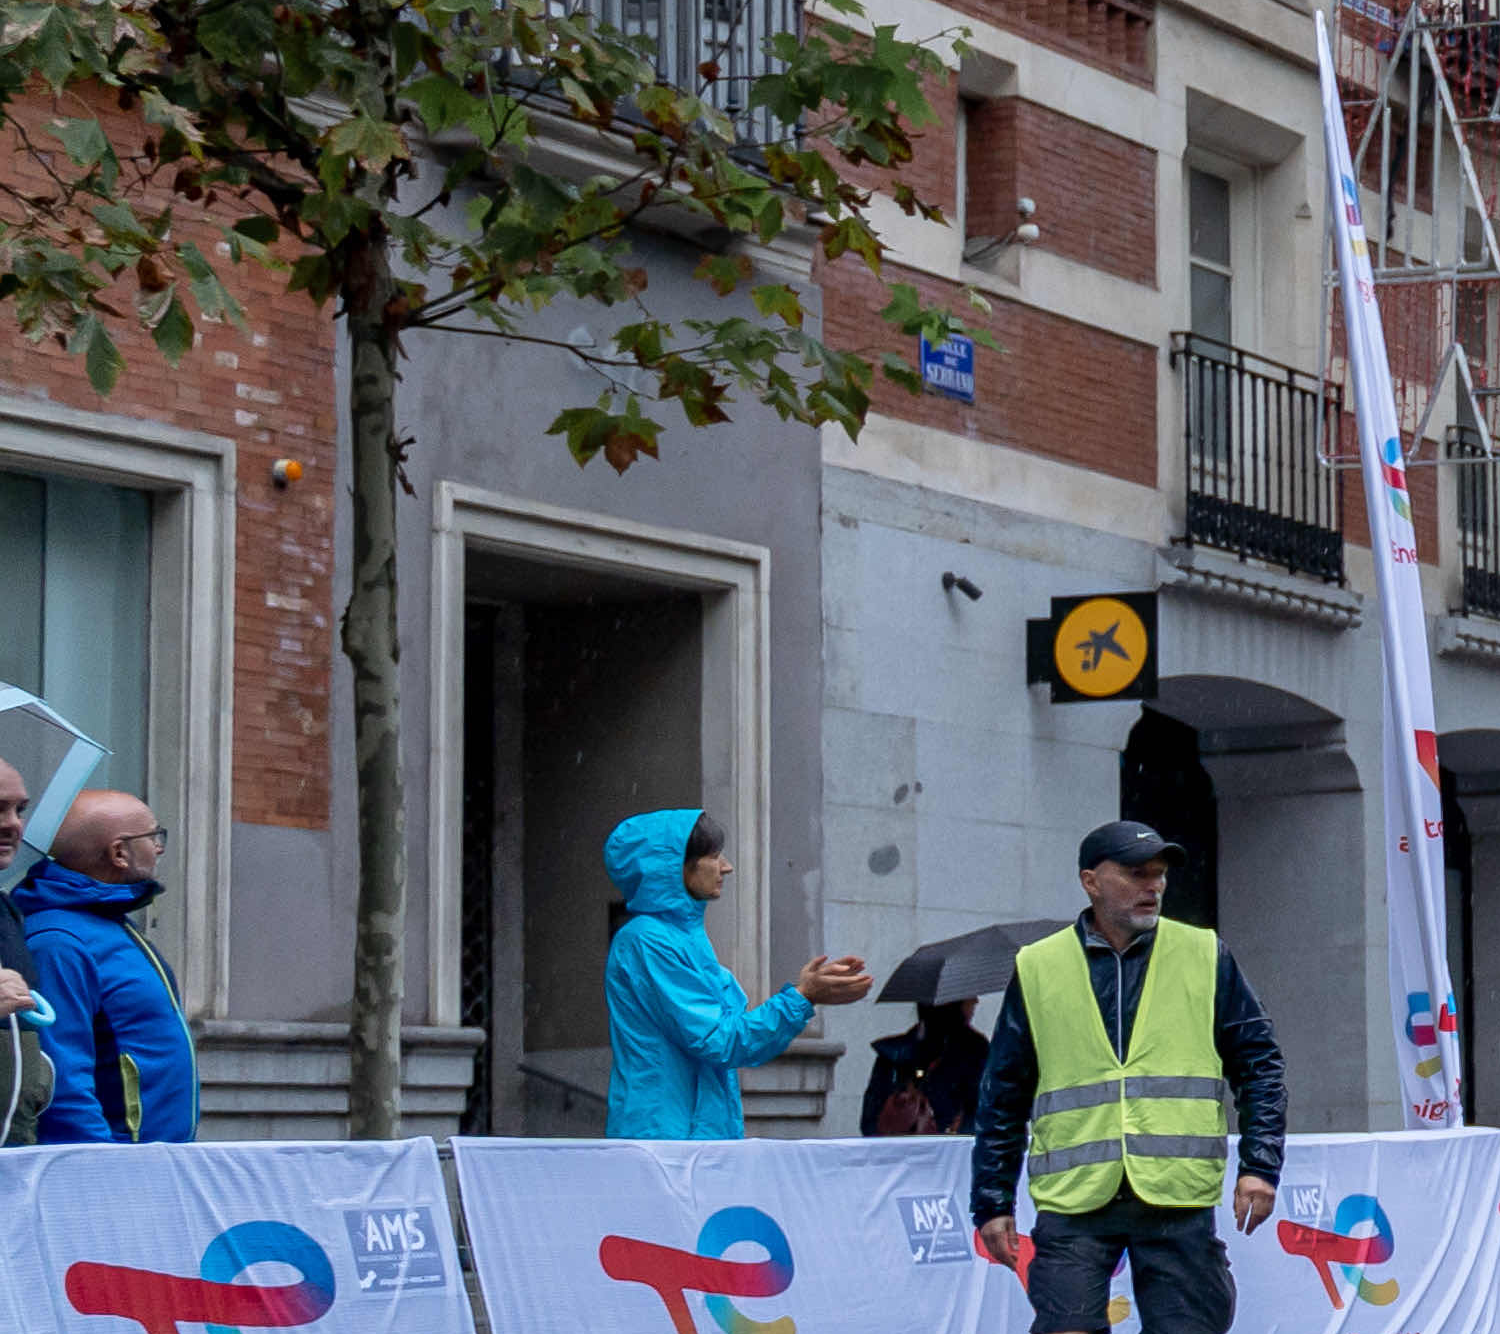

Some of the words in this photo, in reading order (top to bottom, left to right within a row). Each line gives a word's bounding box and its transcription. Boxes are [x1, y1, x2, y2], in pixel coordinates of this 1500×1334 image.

[912, 1197, 953, 1231] AMS
[1293, 1185, 1321, 1217] AMS
[366, 1212, 425, 1252] AMS
